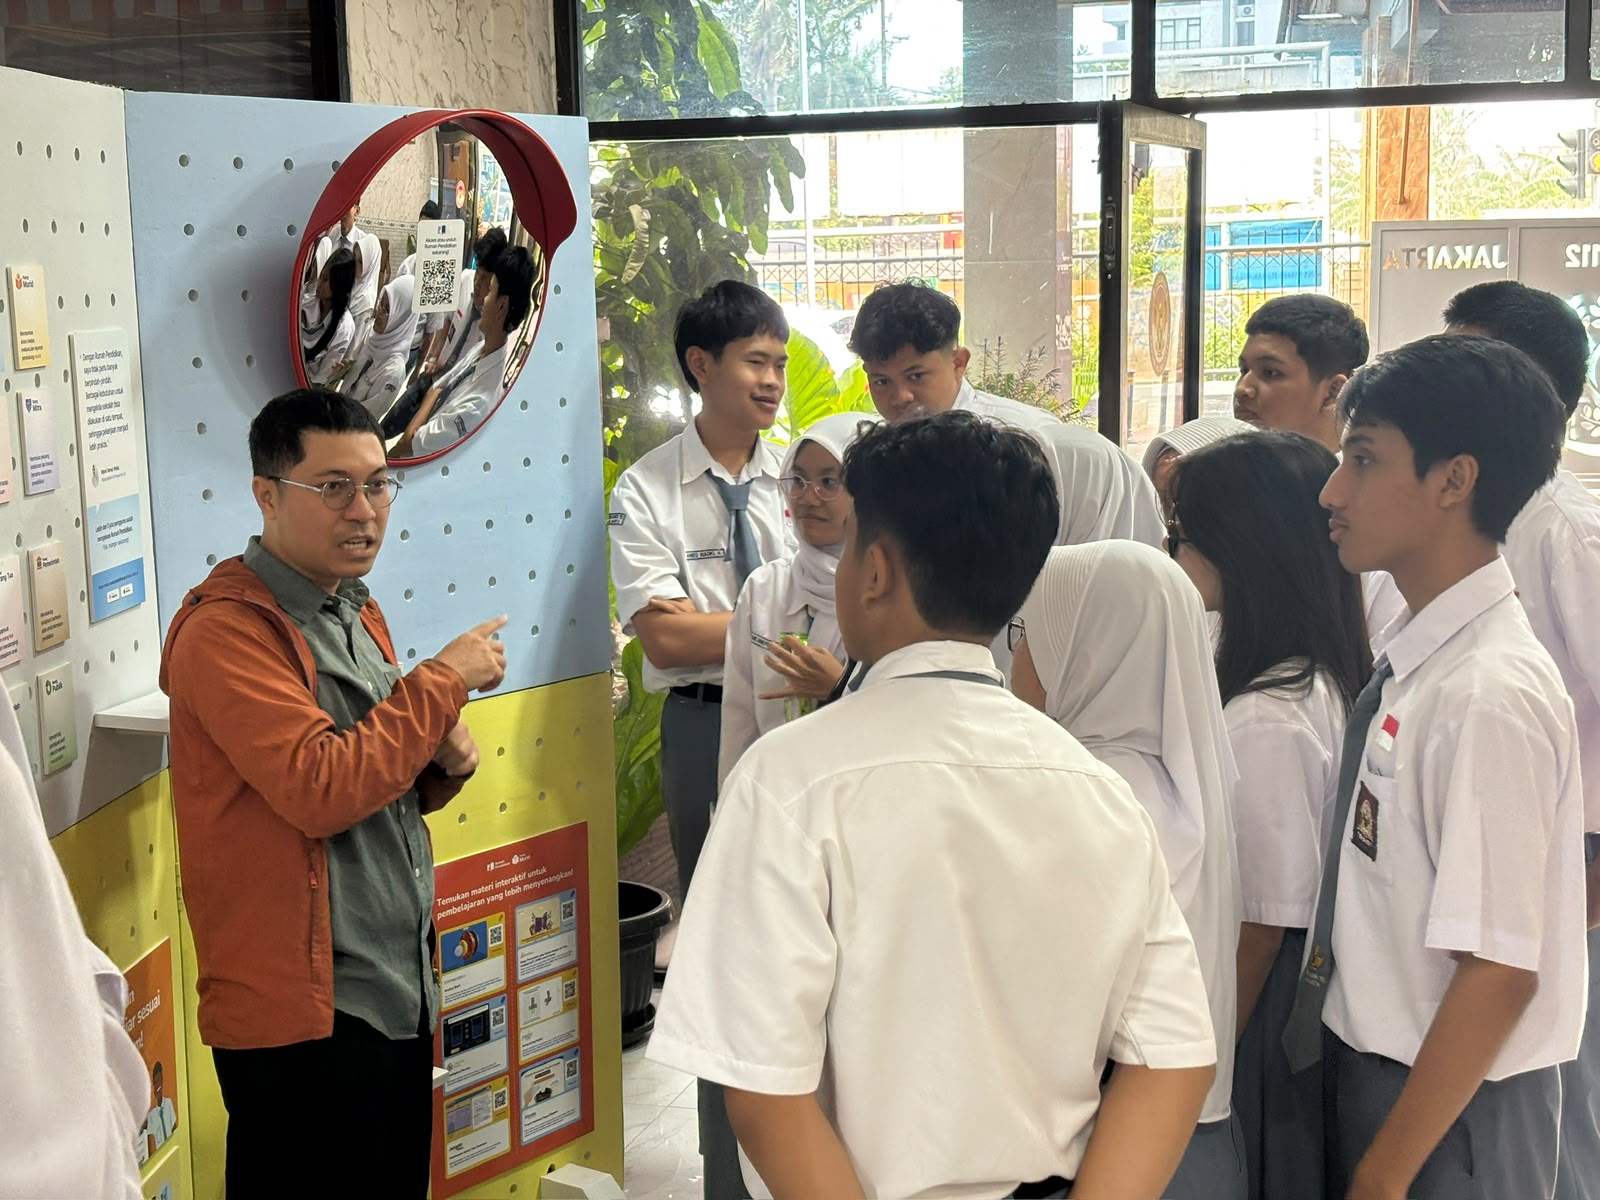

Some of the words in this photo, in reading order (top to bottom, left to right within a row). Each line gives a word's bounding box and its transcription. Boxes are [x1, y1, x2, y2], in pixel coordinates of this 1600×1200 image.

[436, 892, 470, 907] Temukan
[470, 881, 494, 896] materi
[494, 871, 526, 889] interaktif
[527, 866, 547, 878] untuk
[437, 898, 485, 921] pembelajaran
[486, 891, 504, 905] yang
[505, 885, 522, 897] lebih
[523, 868, 574, 891] menyenangkan!
[137, 988, 161, 1024] sesuai
